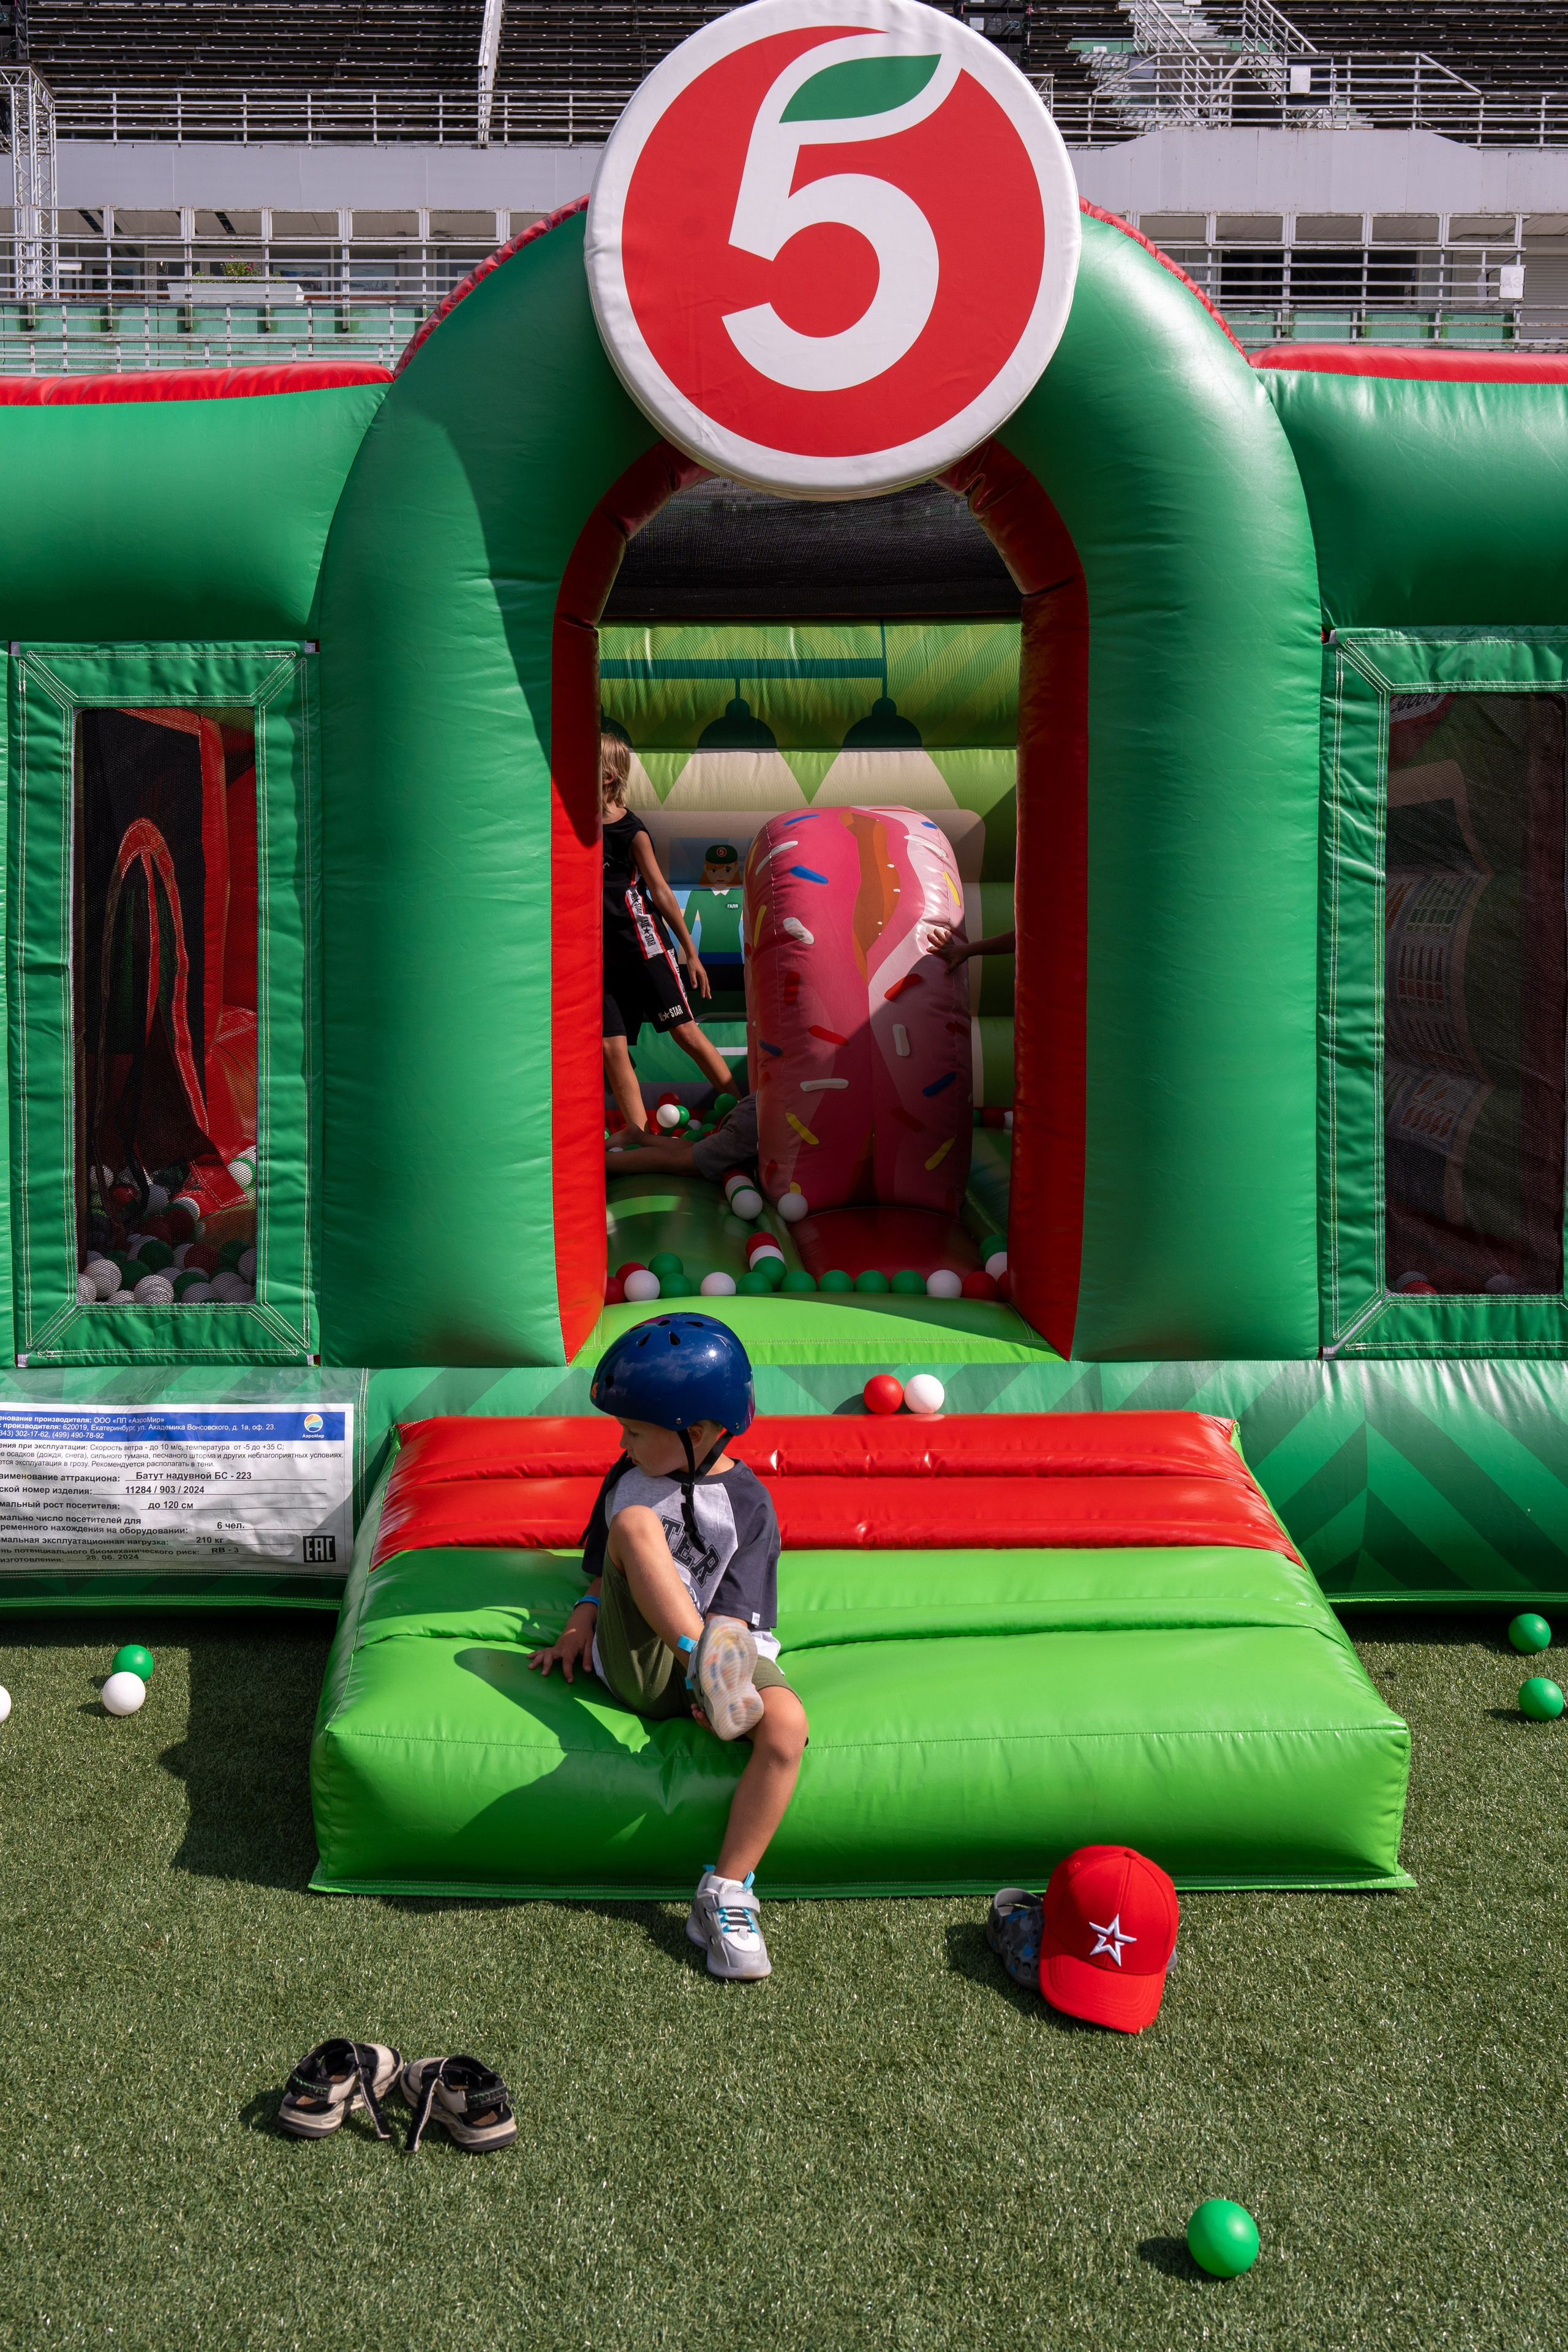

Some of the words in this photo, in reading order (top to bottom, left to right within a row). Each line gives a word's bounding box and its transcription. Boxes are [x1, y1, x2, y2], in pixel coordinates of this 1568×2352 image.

[722, 32, 959, 391] 5
[640, 919, 650, 929] ALL
[645, 933, 656, 947] STAR
[669, 1005, 684, 1018] STAR
[136, 1472, 164, 1481] Батут
[166, 1472, 211, 1481] надувной
[119, 1527, 188, 1536] оборудовании:
[306, 1537, 333, 1561] EAC
